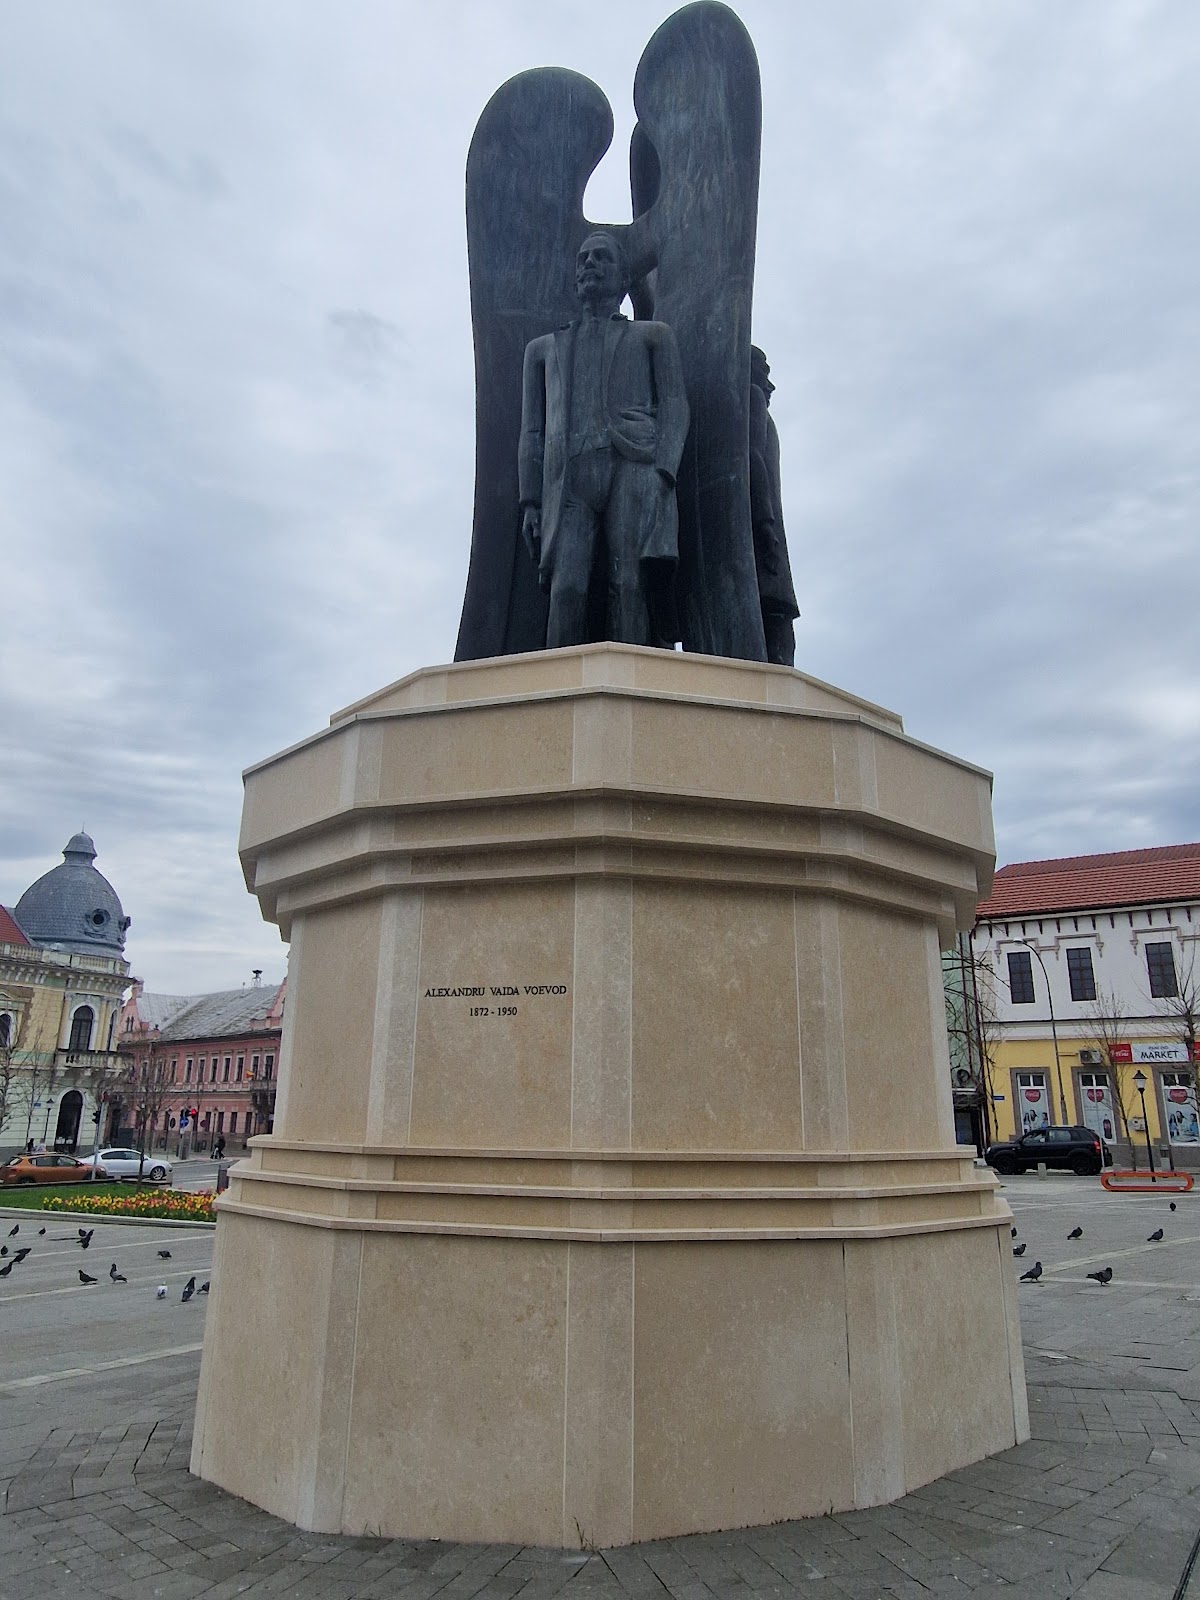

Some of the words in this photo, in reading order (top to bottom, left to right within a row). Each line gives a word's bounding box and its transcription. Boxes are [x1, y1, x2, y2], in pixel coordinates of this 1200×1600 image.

[424, 987, 485, 998] ALEXANDRU
[490, 986, 519, 996] VAIDA
[524, 985, 567, 995] VOEVOD
[469, 1007, 489, 1017] 1872
[498, 1006, 518, 1016] 1950
[1140, 1050, 1179, 1059] MARKET
